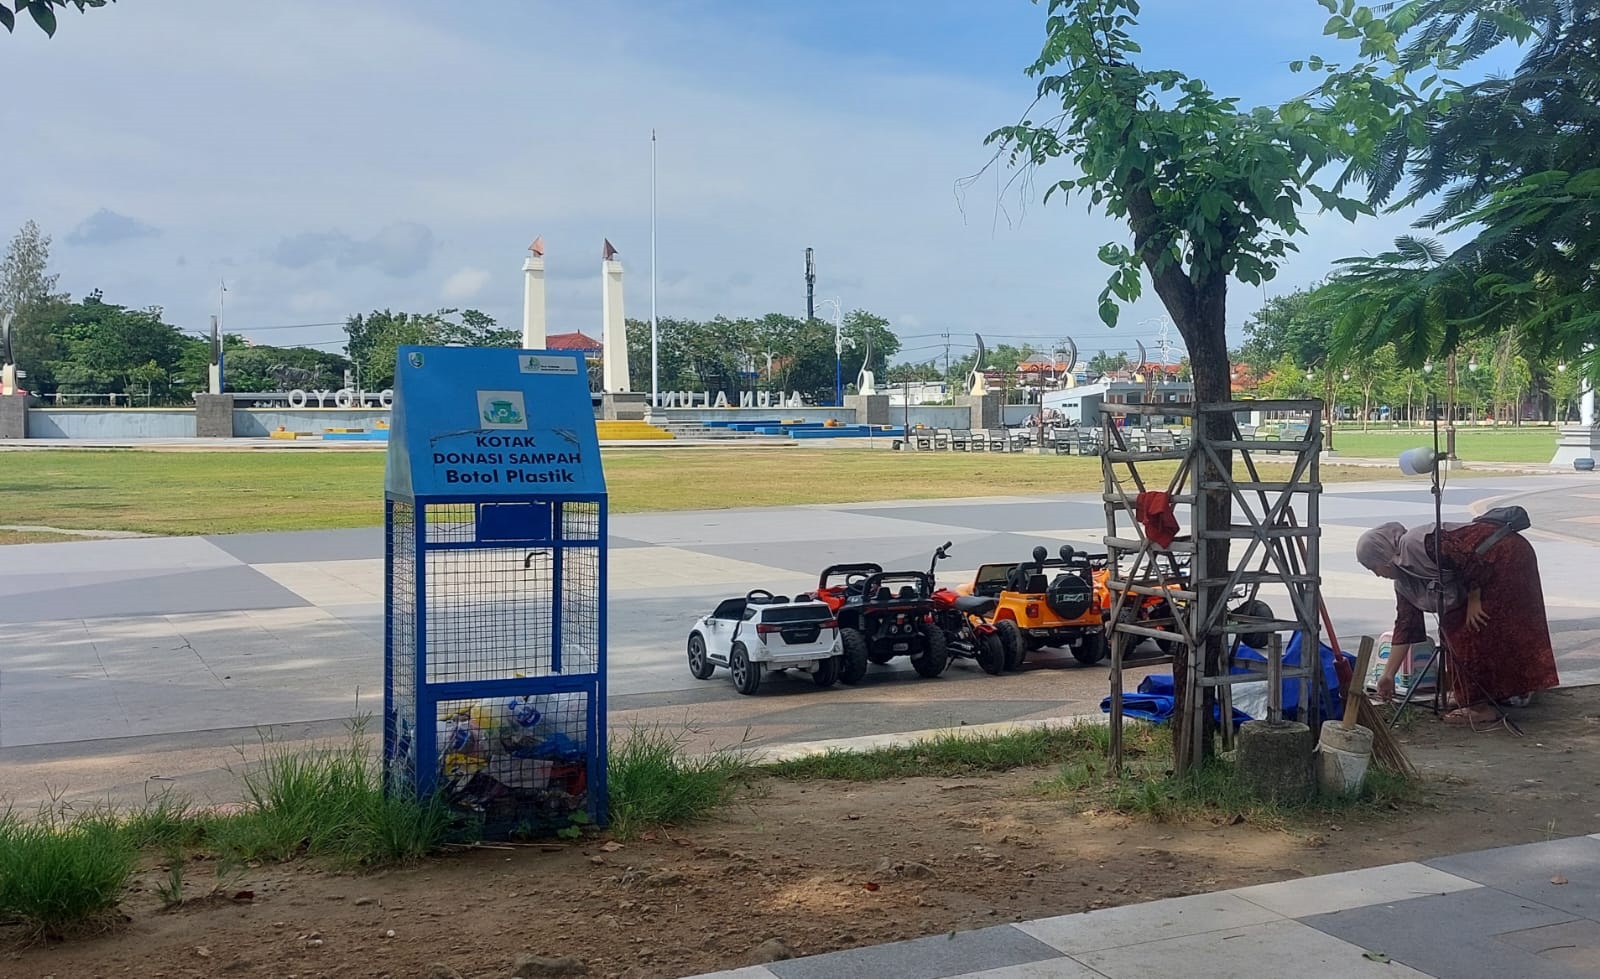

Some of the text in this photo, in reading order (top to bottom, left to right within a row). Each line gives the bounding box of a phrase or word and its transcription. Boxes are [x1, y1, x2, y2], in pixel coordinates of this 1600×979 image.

[476, 437, 535, 448] KOTAK
[433, 453, 581, 464] DONASI SAMPAH
[446, 469, 575, 484] Botol Plastik
